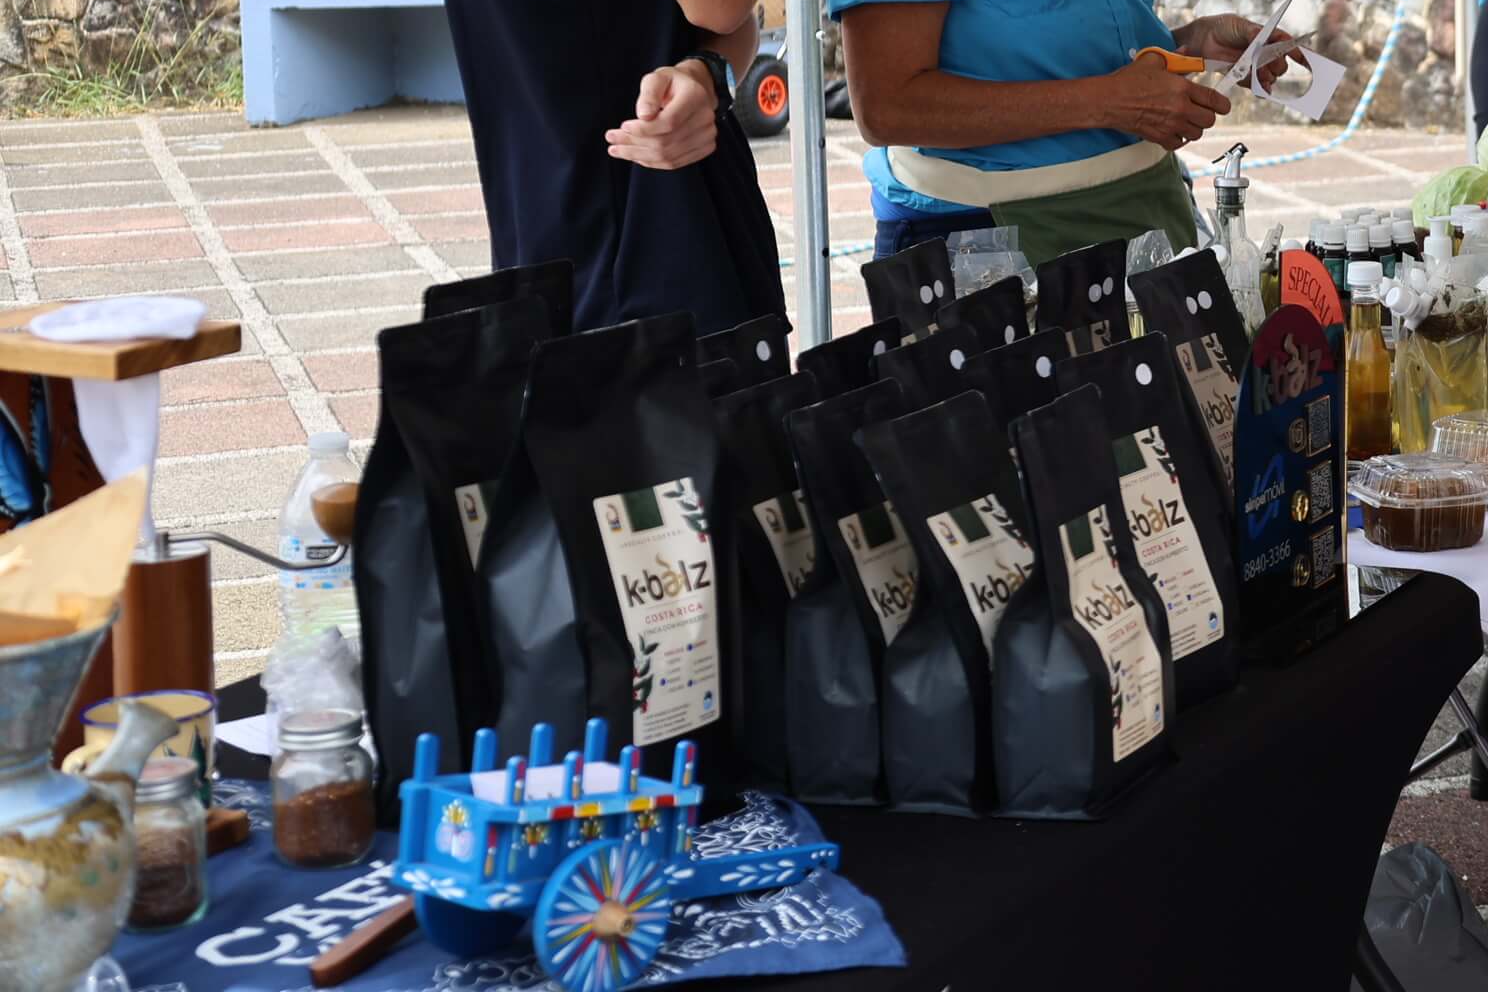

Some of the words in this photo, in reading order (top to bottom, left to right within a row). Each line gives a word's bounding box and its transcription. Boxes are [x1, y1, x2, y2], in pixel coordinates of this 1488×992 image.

[1242, 538, 1292, 582] 8840-3366
[645, 610, 674, 624] COSTA
[677, 603, 703, 617] RICA
